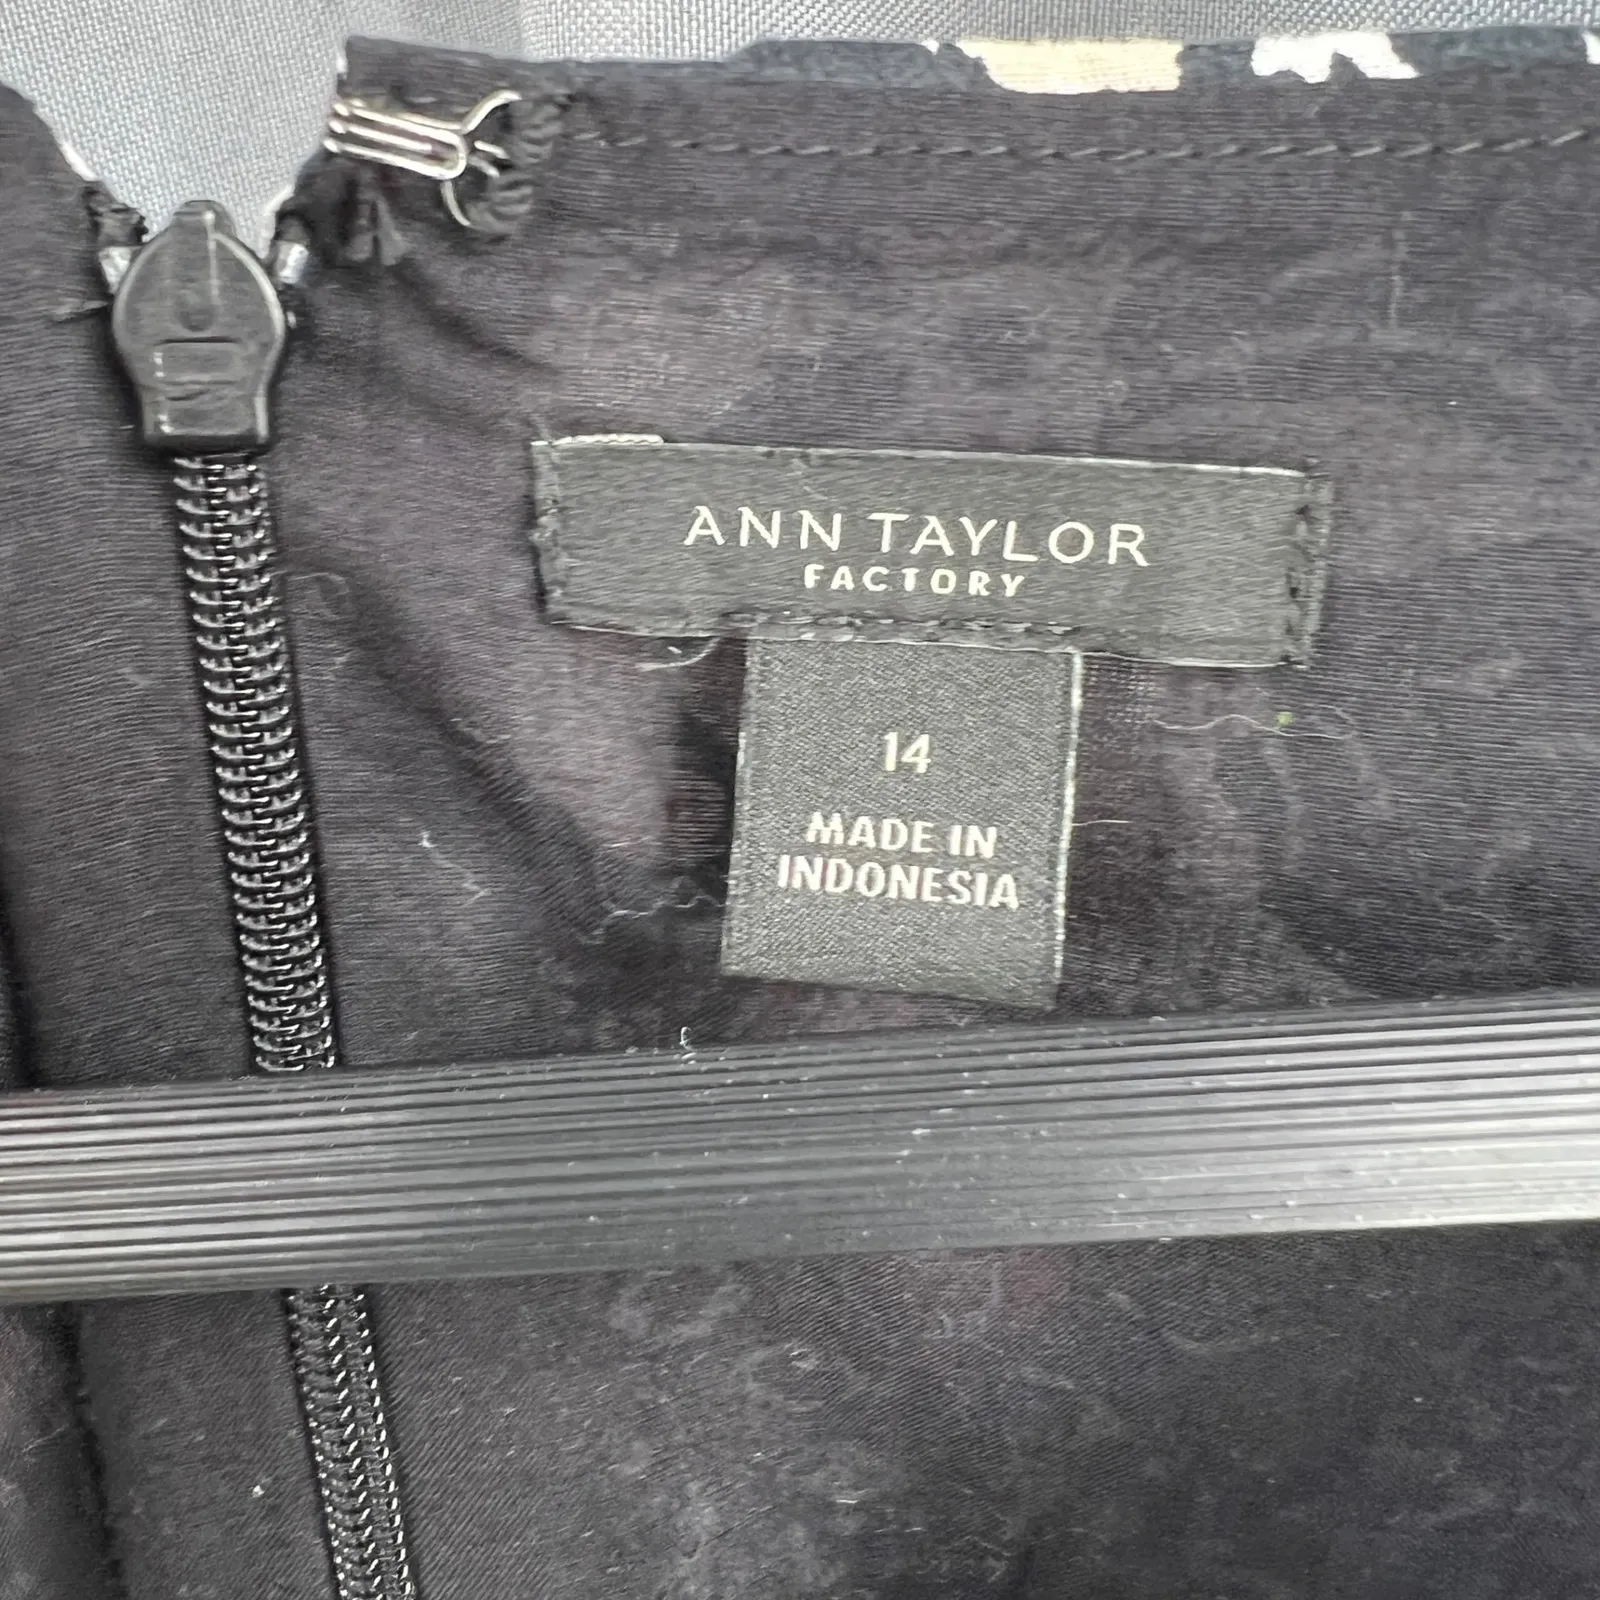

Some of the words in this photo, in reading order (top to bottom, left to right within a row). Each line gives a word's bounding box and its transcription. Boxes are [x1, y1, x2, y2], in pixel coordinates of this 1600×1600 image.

[683, 505, 842, 552] ANN
[867, 512, 1151, 567] TAYLOR
[804, 563, 1026, 598] FACTORY
[882, 730, 933, 774] 14
[804, 811, 935, 853] MADE
[948, 824, 998, 859] IN
[776, 854, 1020, 911] INDONESIA
